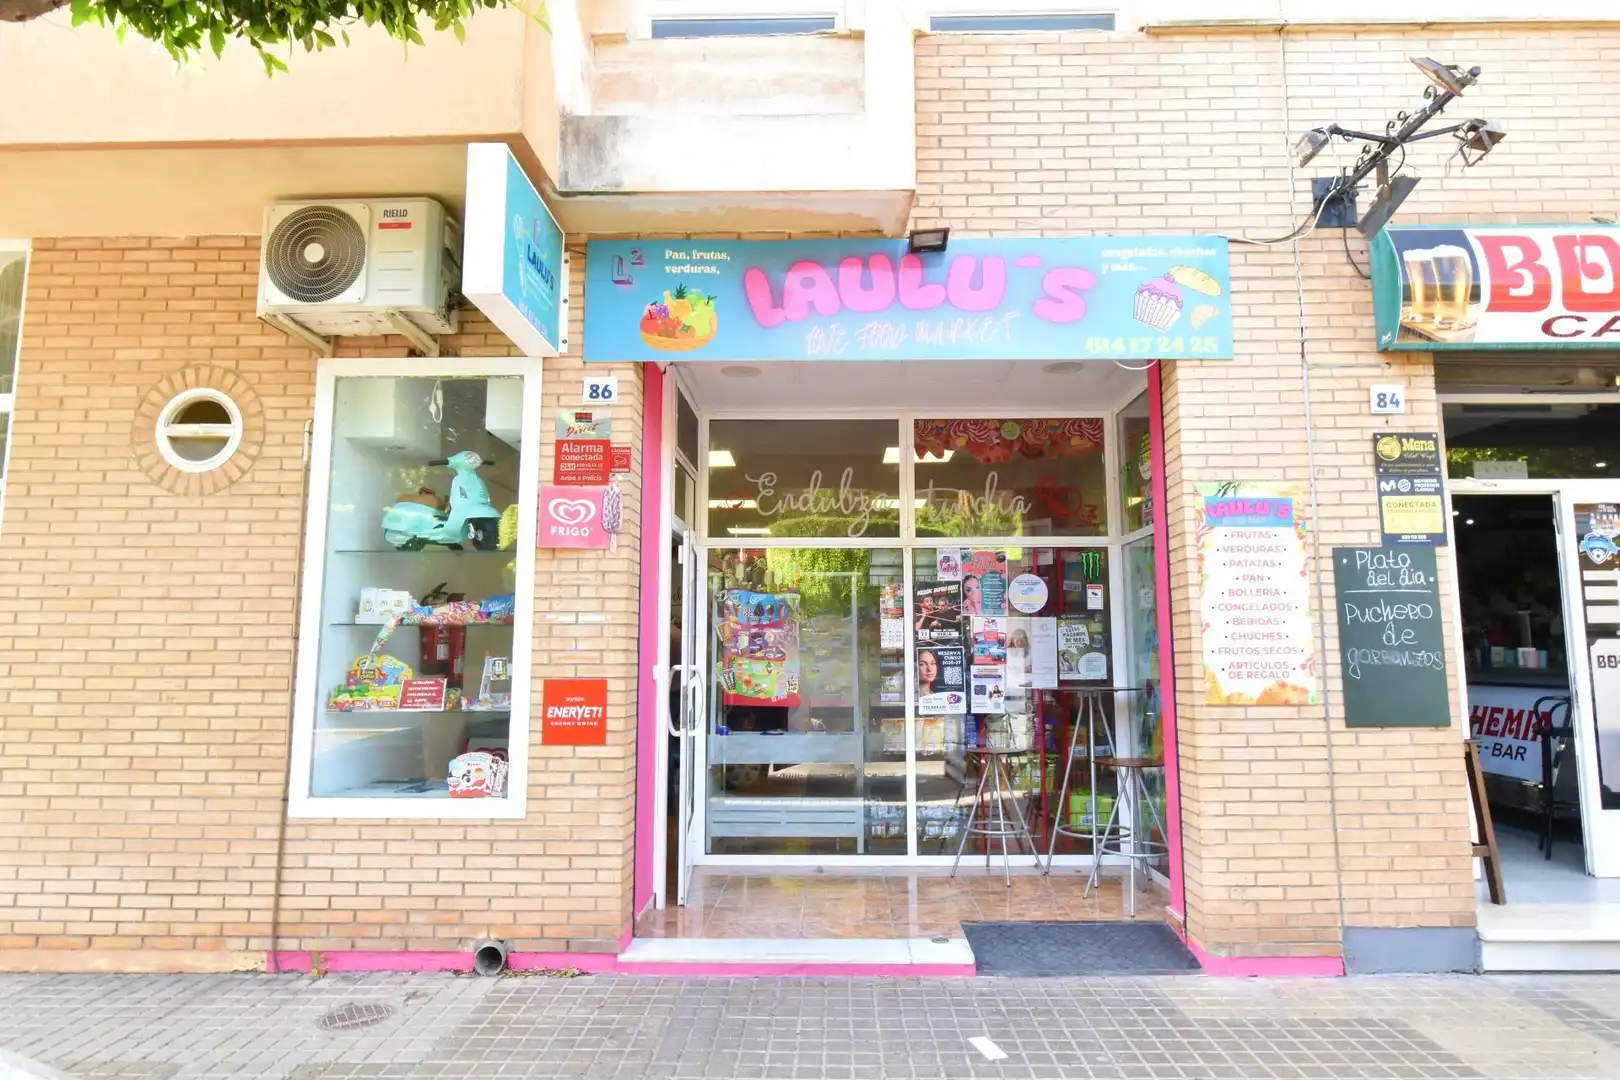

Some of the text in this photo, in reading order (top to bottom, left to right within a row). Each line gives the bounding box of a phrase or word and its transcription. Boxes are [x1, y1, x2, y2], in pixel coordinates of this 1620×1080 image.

[383, 208, 408, 218] RIELLO
[664, 249, 731, 262] Pan, frutas,
[664, 263, 720, 275] verduras,
[589, 384, 613, 399] 86
[1377, 393, 1400, 408] 84
[561, 442, 604, 453] Alarma
[560, 453, 604, 462] conectada
[550, 525, 590, 537] FRIGO
[1230, 530, 1272, 539] FRUTAS
[1222, 545, 1281, 554] VERDURAS
[1229, 559, 1277, 568] PATATAS
[1355, 549, 1411, 570] Plato
[1241, 573, 1265, 582] PAN
[1366, 570, 1396, 586] del
[1231, 617, 1280, 626] BEBIDAS
[1230, 632, 1283, 641] CHUCHES
[1382, 621, 1419, 647] de
[1217, 646, 1300, 655] FRUTOS SECOS
[1228, 671, 1290, 679] DE REGALO
[547, 705, 603, 720] ENERYETI
